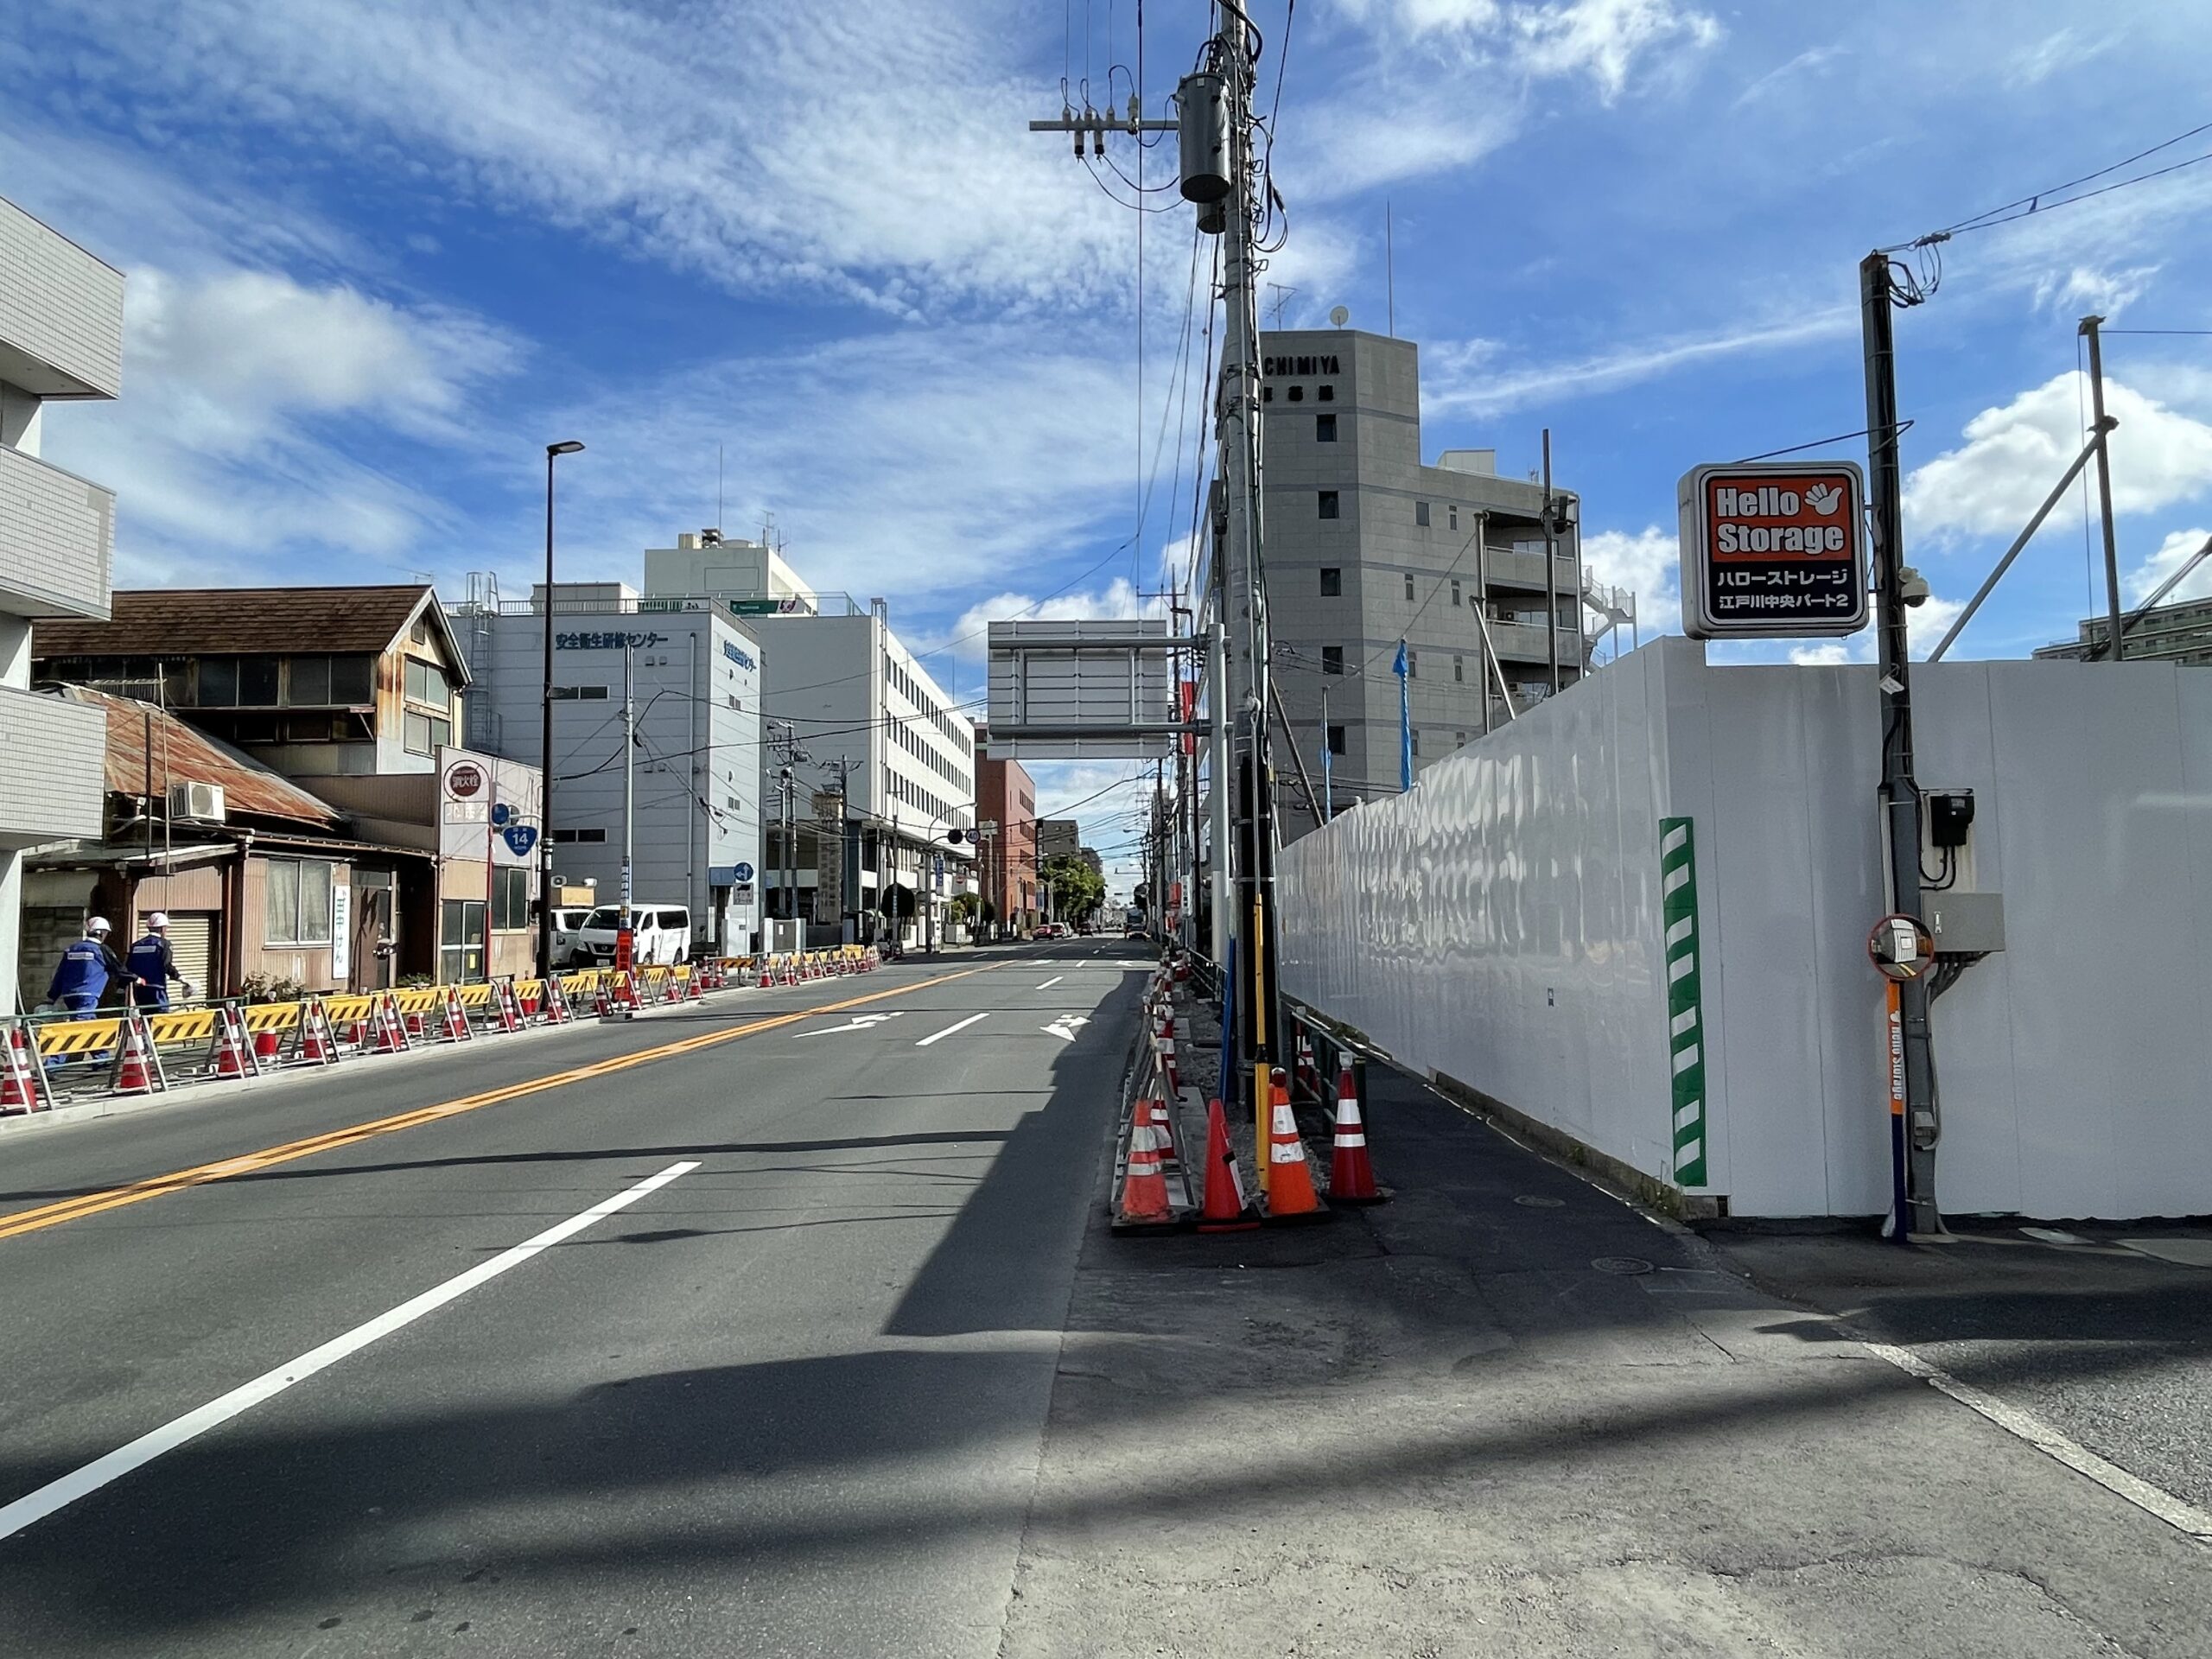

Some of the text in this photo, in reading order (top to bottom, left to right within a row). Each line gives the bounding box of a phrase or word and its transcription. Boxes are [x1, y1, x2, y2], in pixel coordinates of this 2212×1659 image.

[1716, 487, 1800, 517] Hello
[1717, 523, 1844, 555] Storage
[1717, 569, 1848, 587] ハローストレージ
[1719, 594, 1849, 609] 江戸川中央パート2
[556, 632, 668, 650] 安全衛生研修センター
[512, 833, 528, 845] 14
